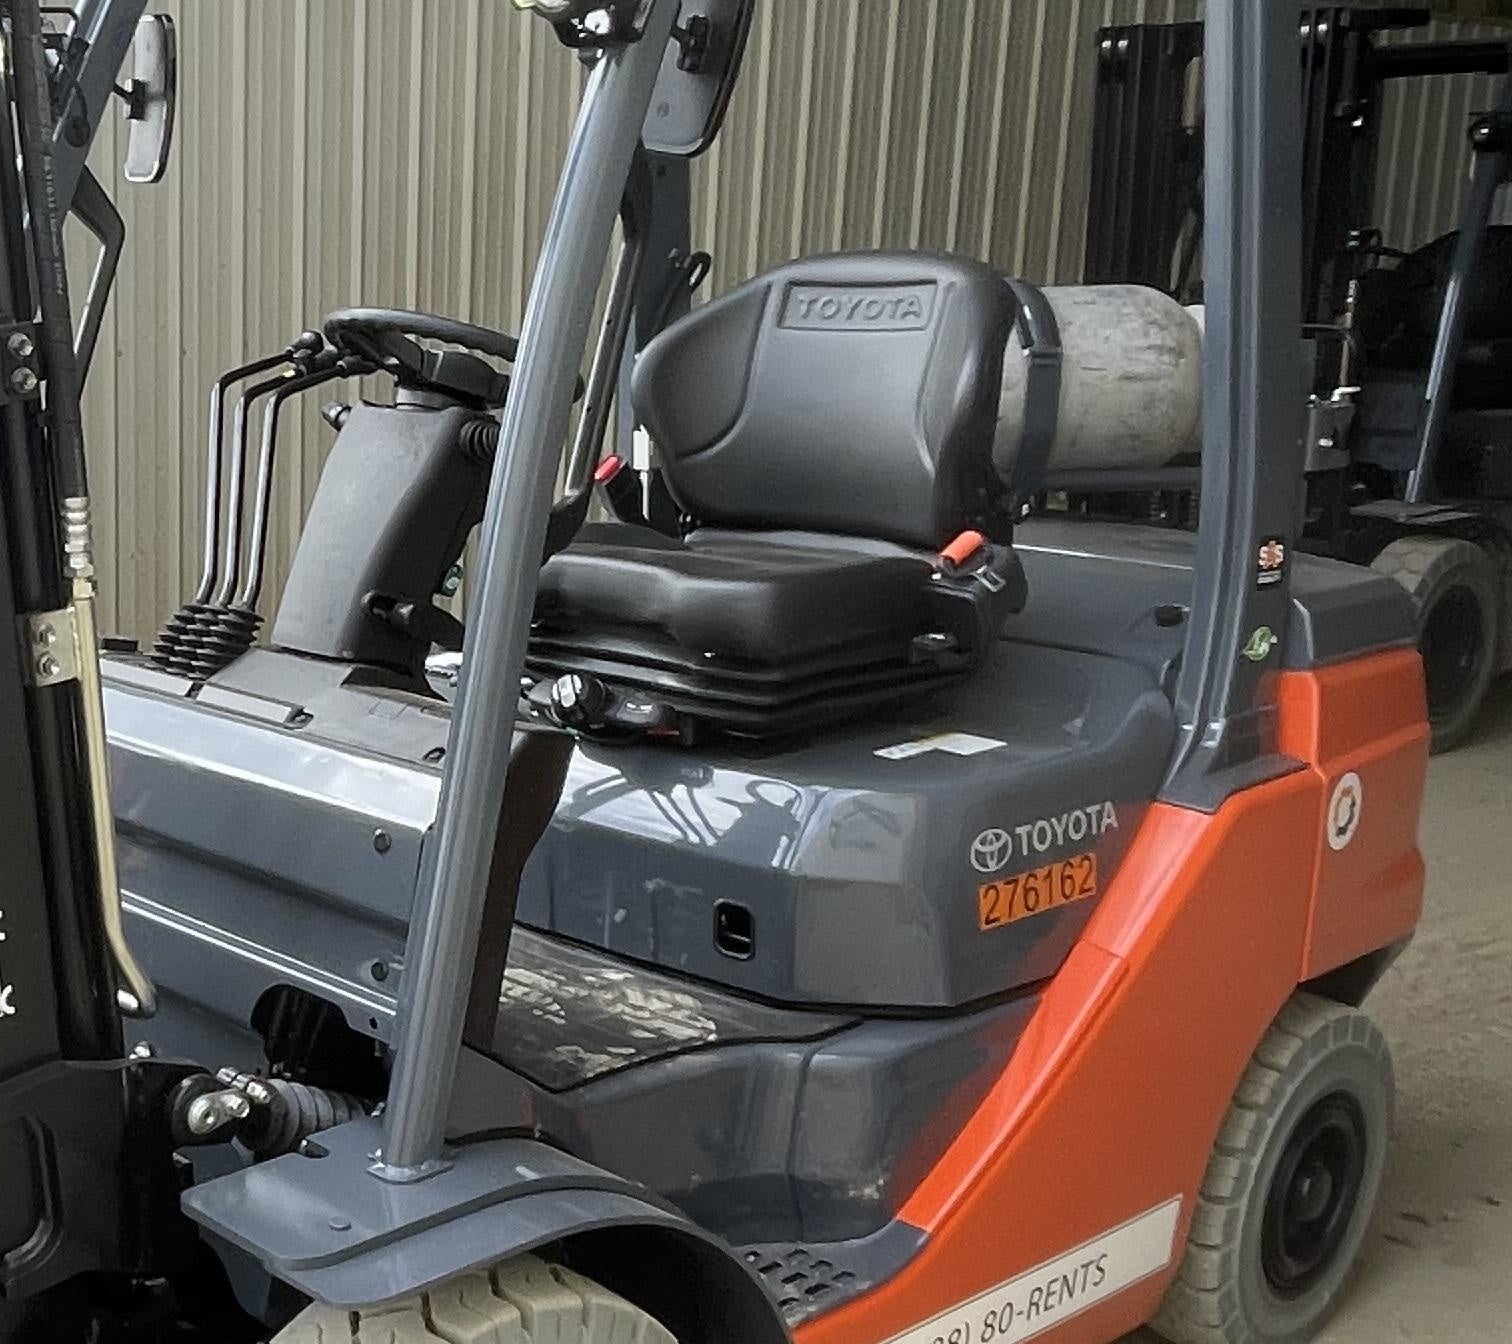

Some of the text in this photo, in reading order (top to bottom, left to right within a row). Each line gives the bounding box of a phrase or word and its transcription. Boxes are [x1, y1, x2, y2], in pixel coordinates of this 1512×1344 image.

[797, 293, 923, 321] TOYOTA
[1014, 800, 1120, 856] TOYOTA
[982, 854, 1093, 925] 276162
[980, 1253, 1108, 1344] 80-RENTS
